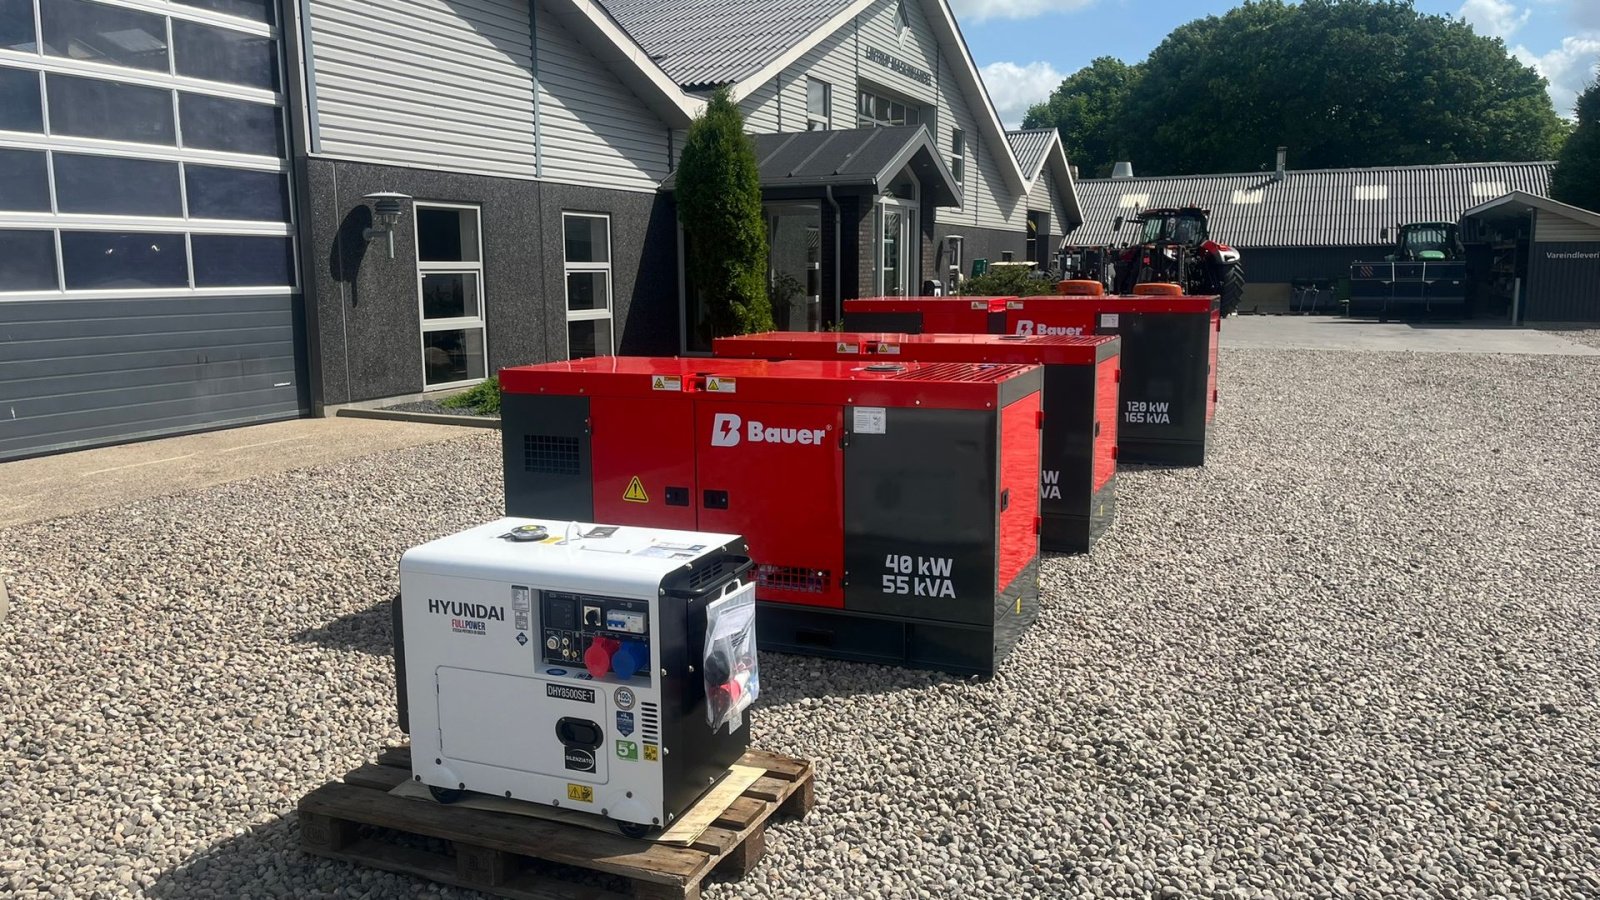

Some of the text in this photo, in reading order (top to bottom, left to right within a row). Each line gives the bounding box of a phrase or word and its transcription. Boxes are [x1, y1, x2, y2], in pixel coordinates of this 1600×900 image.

[1127, 401, 1169, 413] 120 kW
[1125, 412, 1170, 424] 165 kVA
[1041, 470, 1060, 484] W
[885, 554, 953, 577] 40 kW
[882, 574, 956, 599] 55 kVA
[428, 598, 505, 622] HYUNDAI
[547, 685, 594, 701] DHY8500SE-T
